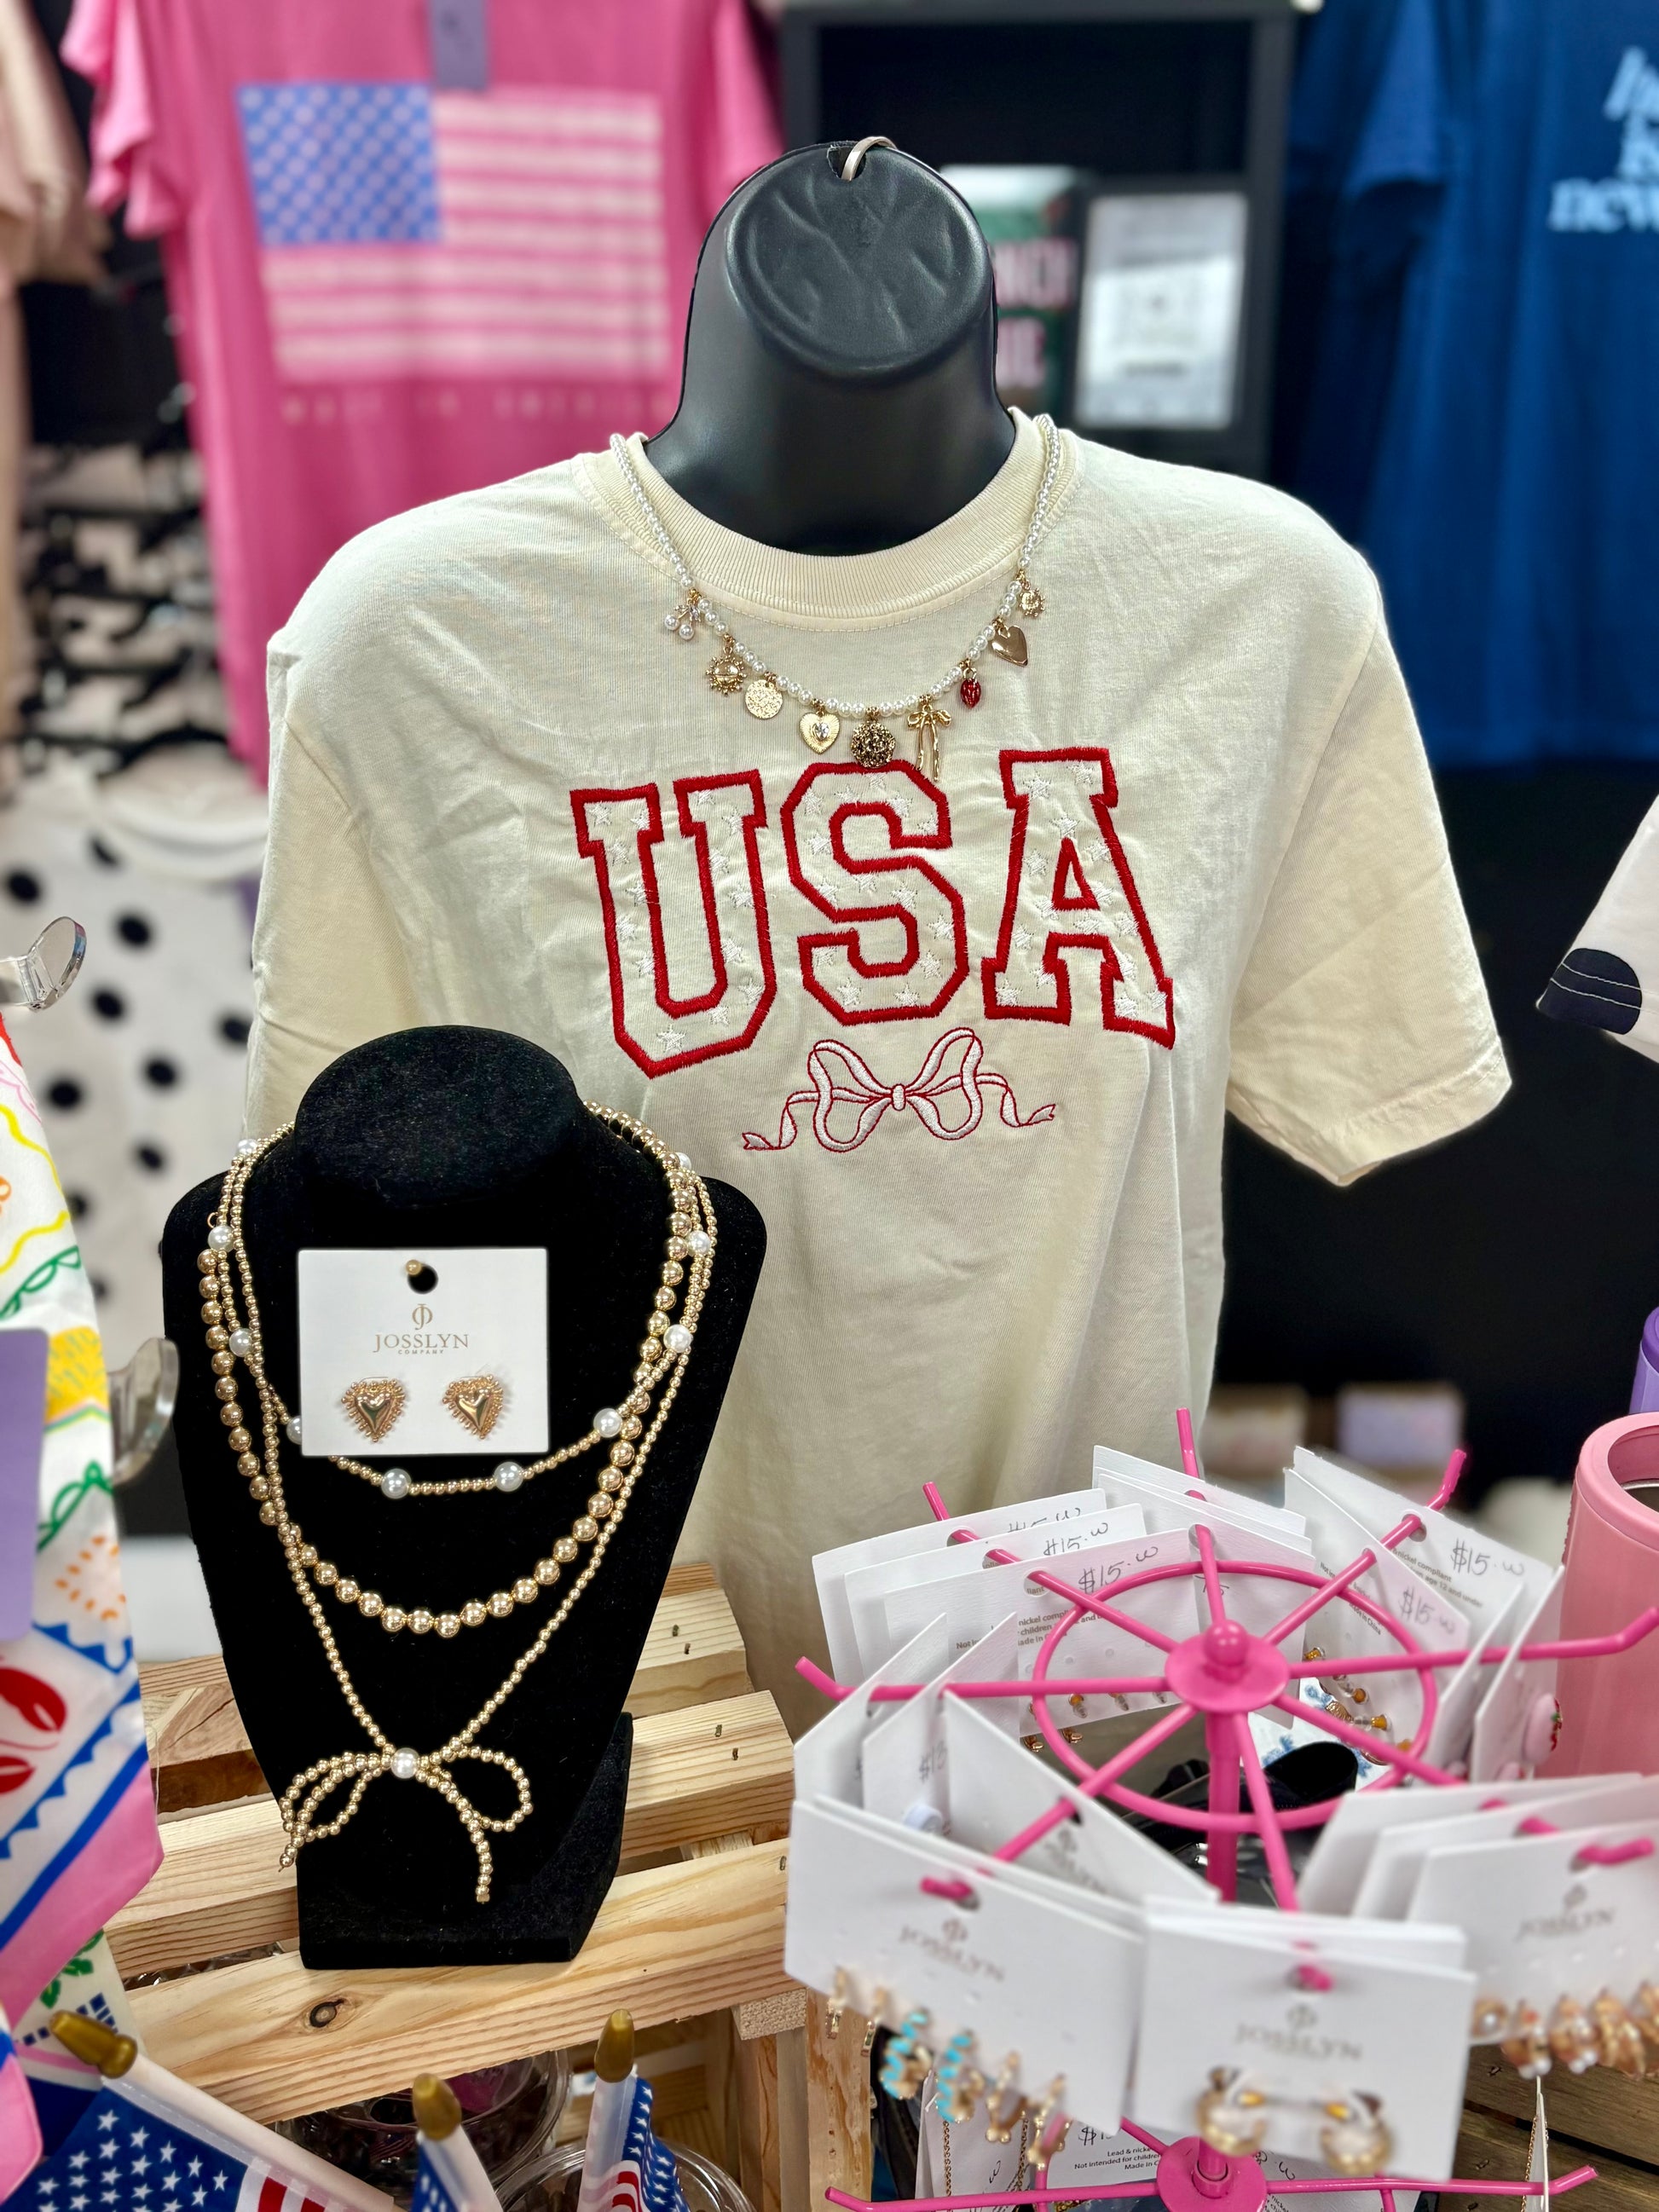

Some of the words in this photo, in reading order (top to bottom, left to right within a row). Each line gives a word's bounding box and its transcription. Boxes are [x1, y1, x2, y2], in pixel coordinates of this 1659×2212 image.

[569, 748, 1176, 1079] USA
[373, 1333, 469, 1354] JOSSLYN
[1418, 1562, 1453, 1583] compliant
[1089, 2157, 1121, 2168] intended
[1133, 2153, 1161, 2163] childre
[1107, 2149, 1124, 2157] Lead
[1132, 2146, 1151, 2154] nicke
